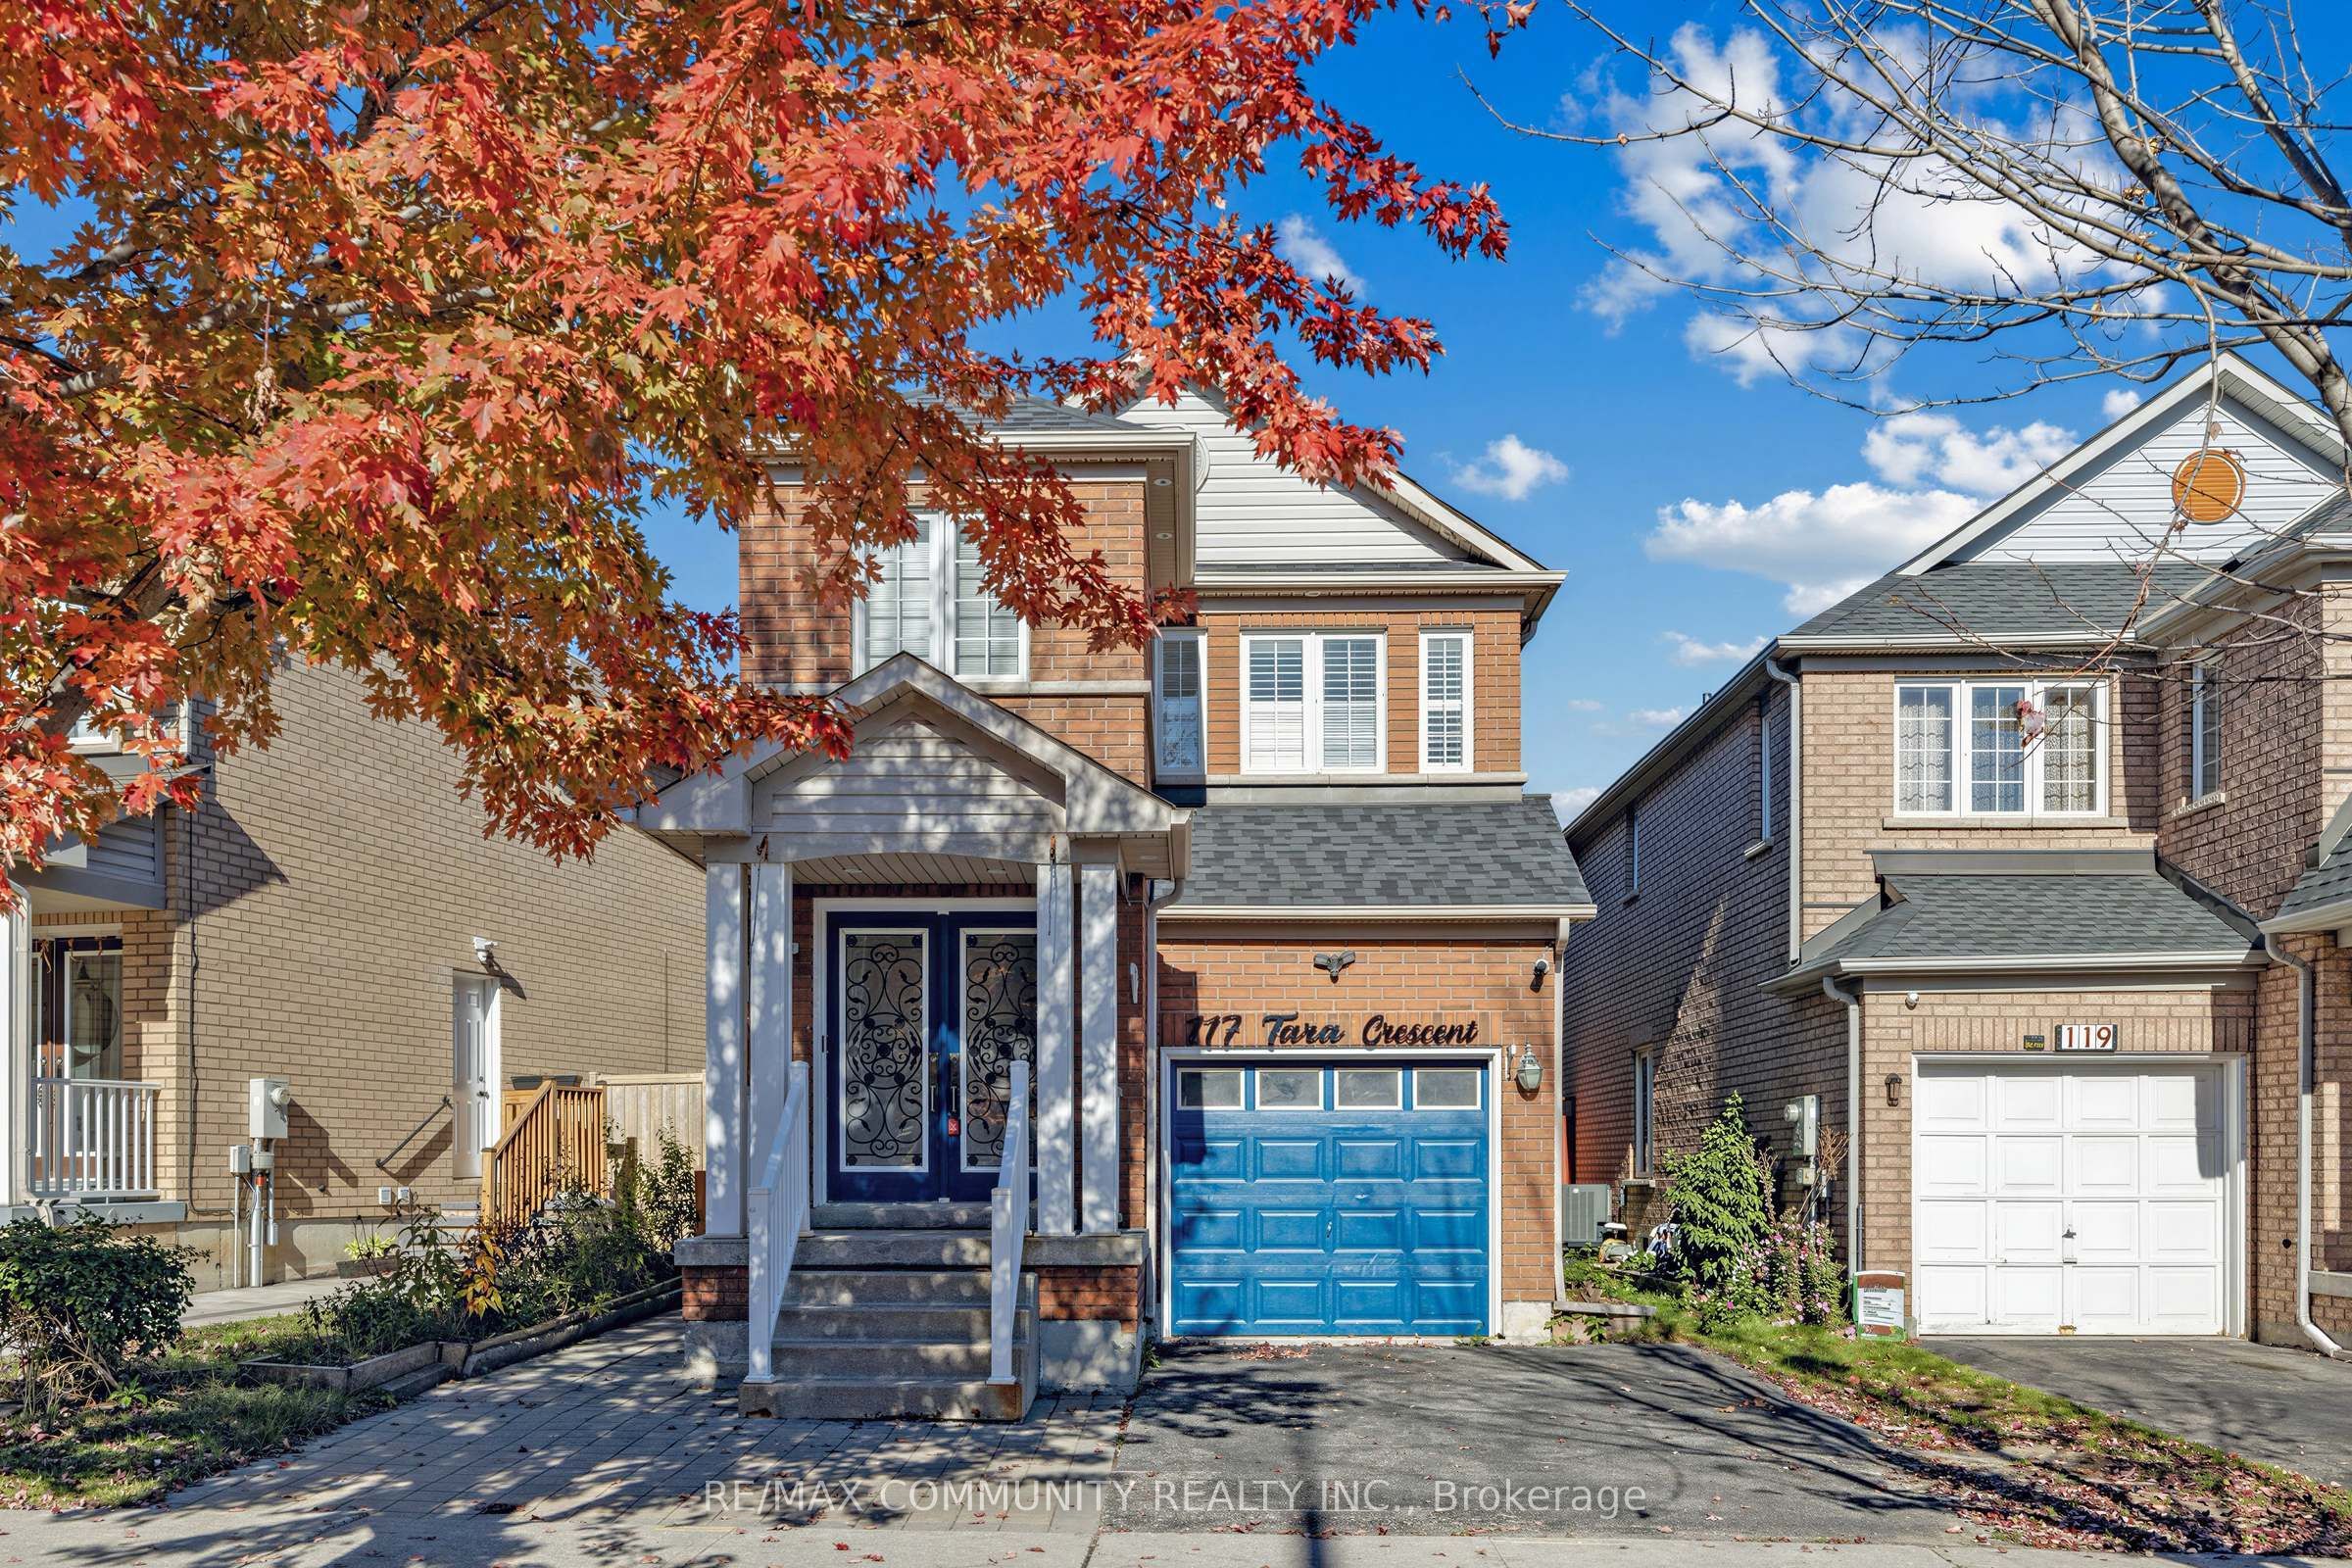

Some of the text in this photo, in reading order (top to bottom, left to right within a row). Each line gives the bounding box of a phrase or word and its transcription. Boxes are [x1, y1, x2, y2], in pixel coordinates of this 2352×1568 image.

[1186, 1011, 1479, 1053] 117 Tara Crescent
[2067, 1026, 2112, 1049] 119
